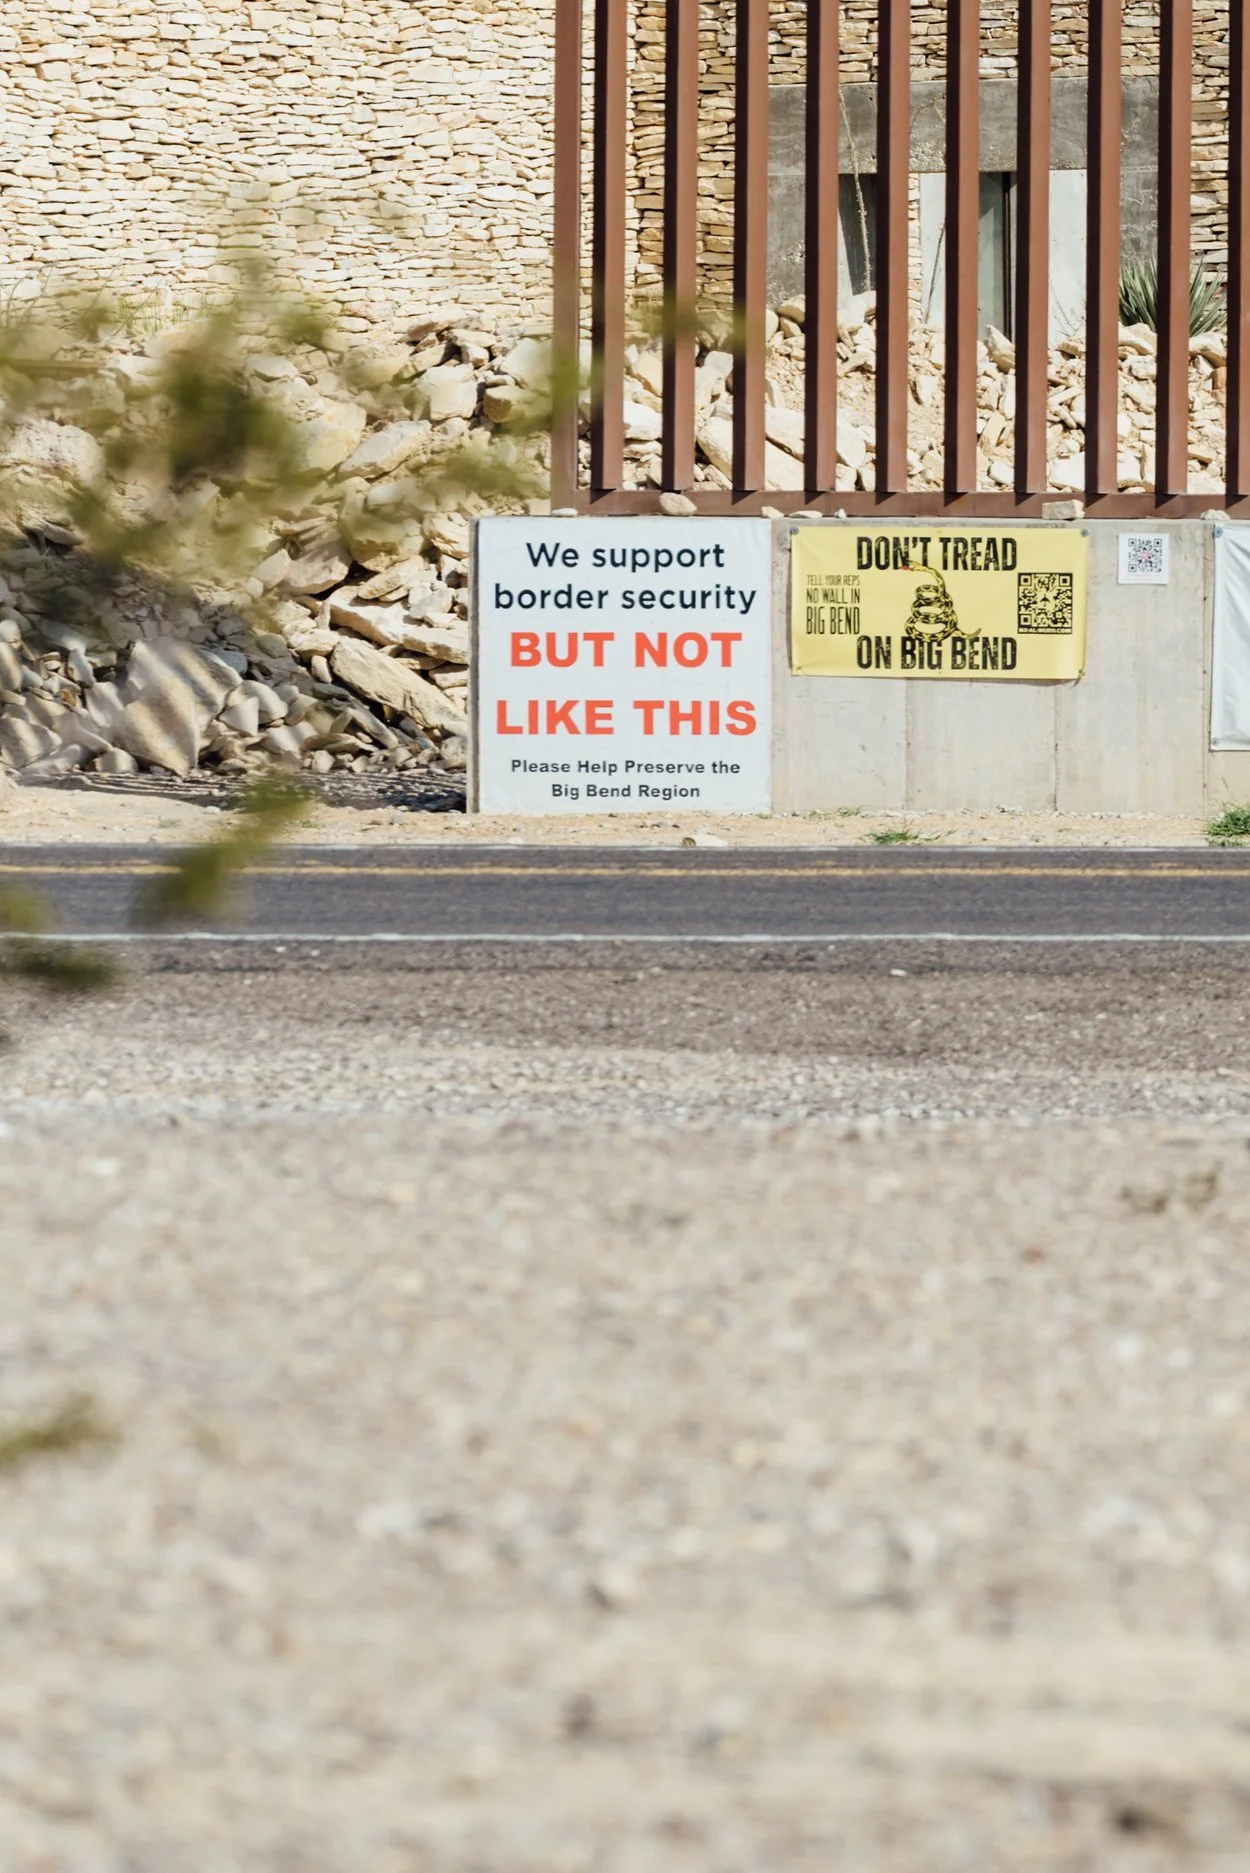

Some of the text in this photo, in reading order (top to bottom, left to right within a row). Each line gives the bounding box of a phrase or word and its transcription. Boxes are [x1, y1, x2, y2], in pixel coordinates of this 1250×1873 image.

[526, 542, 725, 573] We support
[857, 536, 1017, 571] DON'T TREAD
[806, 574, 861, 587] TELL YOUR REPS
[806, 587, 861, 605] NO WALL IN
[495, 582, 757, 615] border security
[807, 606, 861, 635] BIG BEND
[510, 631, 743, 668] BUT NOT
[856, 635, 1017, 670] ON BIG BEND
[496, 699, 757, 736] LIKE THIS
[511, 759, 741, 776] Please Help Preserve the
[551, 783, 700, 801] Big Bend Region
